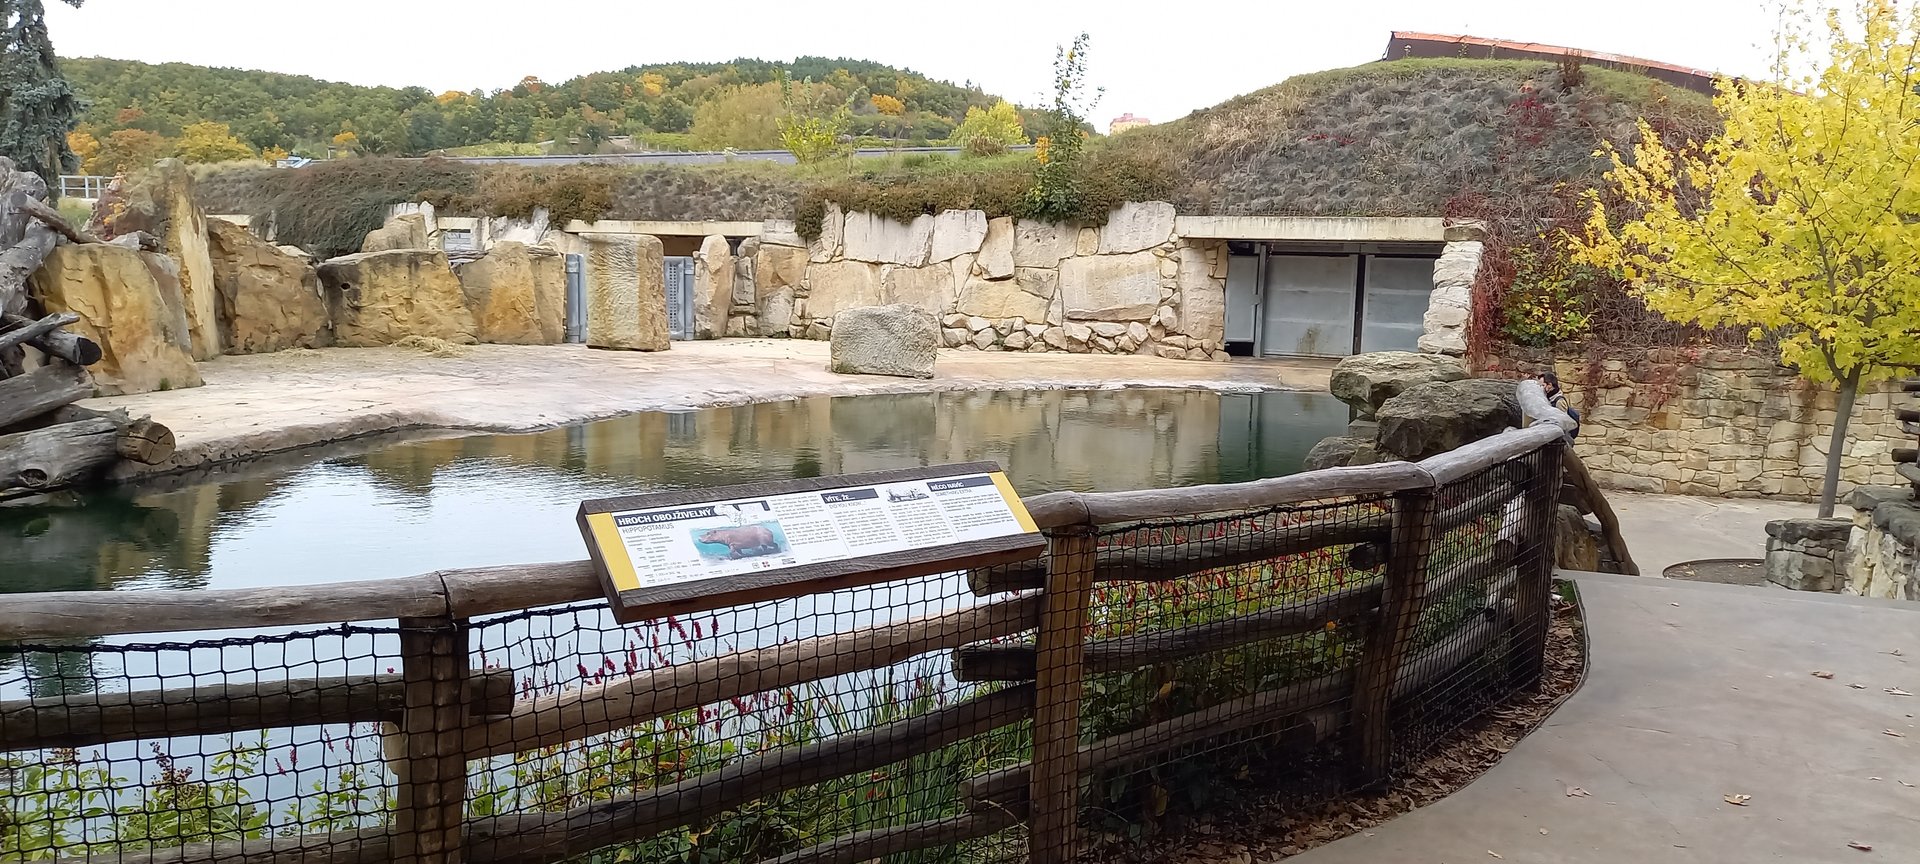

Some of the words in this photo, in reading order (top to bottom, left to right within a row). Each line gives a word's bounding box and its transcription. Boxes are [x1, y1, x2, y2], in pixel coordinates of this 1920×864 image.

[617, 515, 651, 526] HROCH
[652, 507, 712, 522] OBOJŽIVELNÝ
[621, 522, 675, 534] HIPPOPOTAMUS
